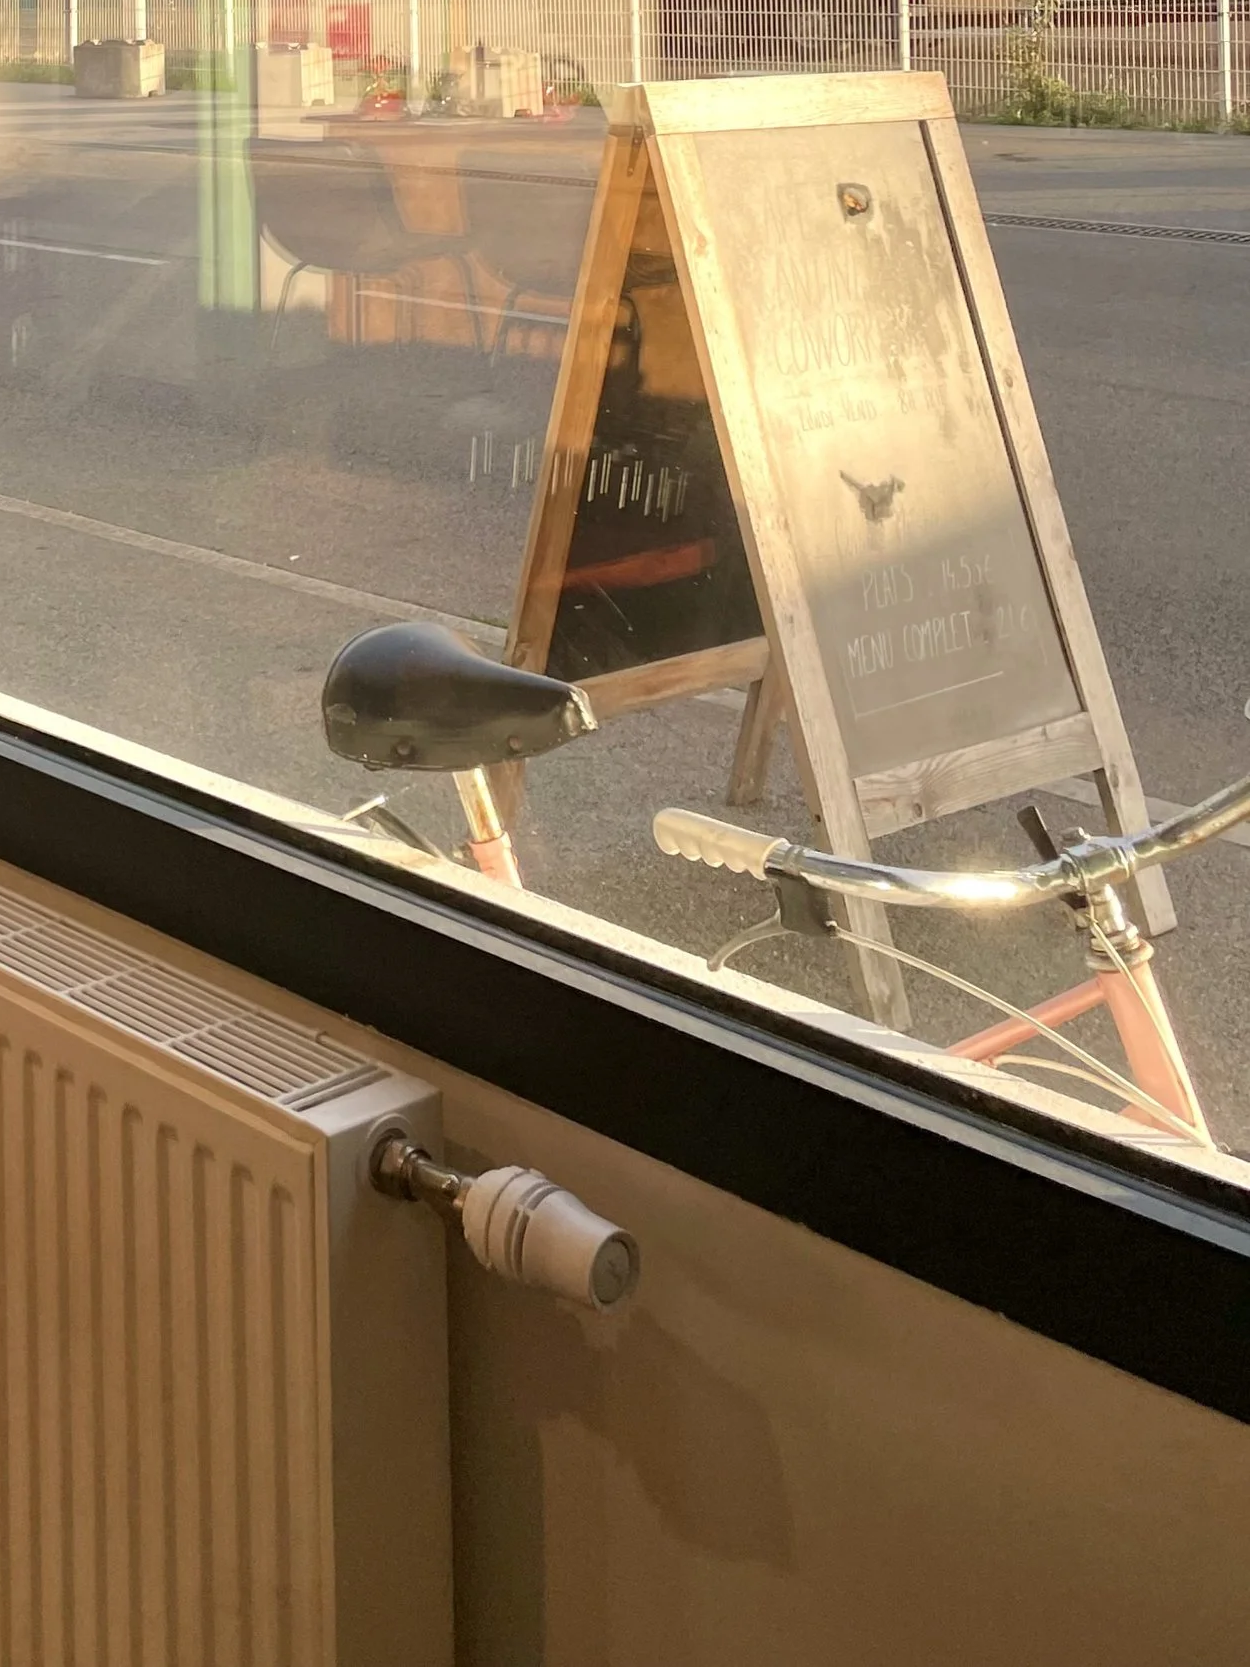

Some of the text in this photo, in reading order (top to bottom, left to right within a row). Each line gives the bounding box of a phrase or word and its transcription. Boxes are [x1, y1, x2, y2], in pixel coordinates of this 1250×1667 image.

[861, 563, 914, 612] PLATS
[847, 628, 895, 680] MENU
[903, 610, 974, 663] COMPLET
